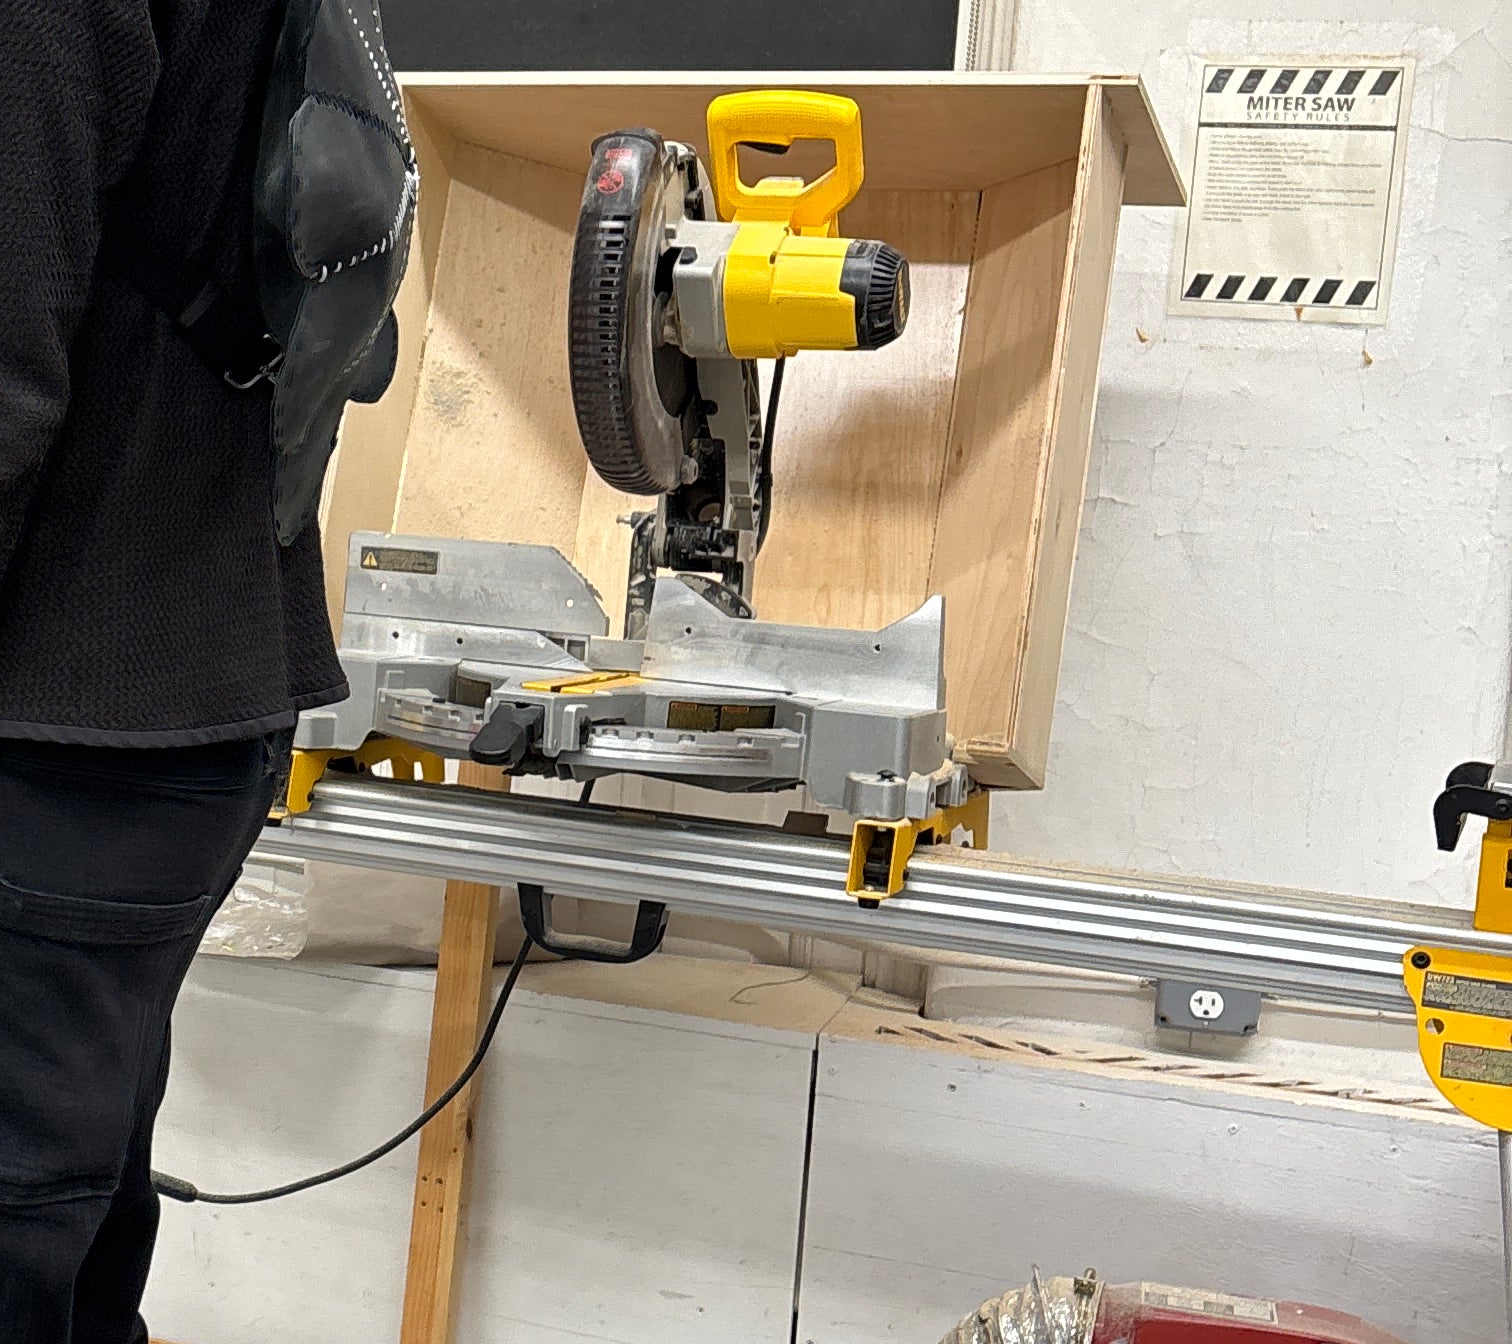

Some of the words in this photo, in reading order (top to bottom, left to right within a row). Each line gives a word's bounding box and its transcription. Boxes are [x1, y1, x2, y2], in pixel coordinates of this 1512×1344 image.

[1247, 96, 1306, 111] MITER
[1311, 97, 1356, 112] SAW
[1247, 111, 1299, 121] SAFETY
[1306, 112, 1350, 122] RULES
